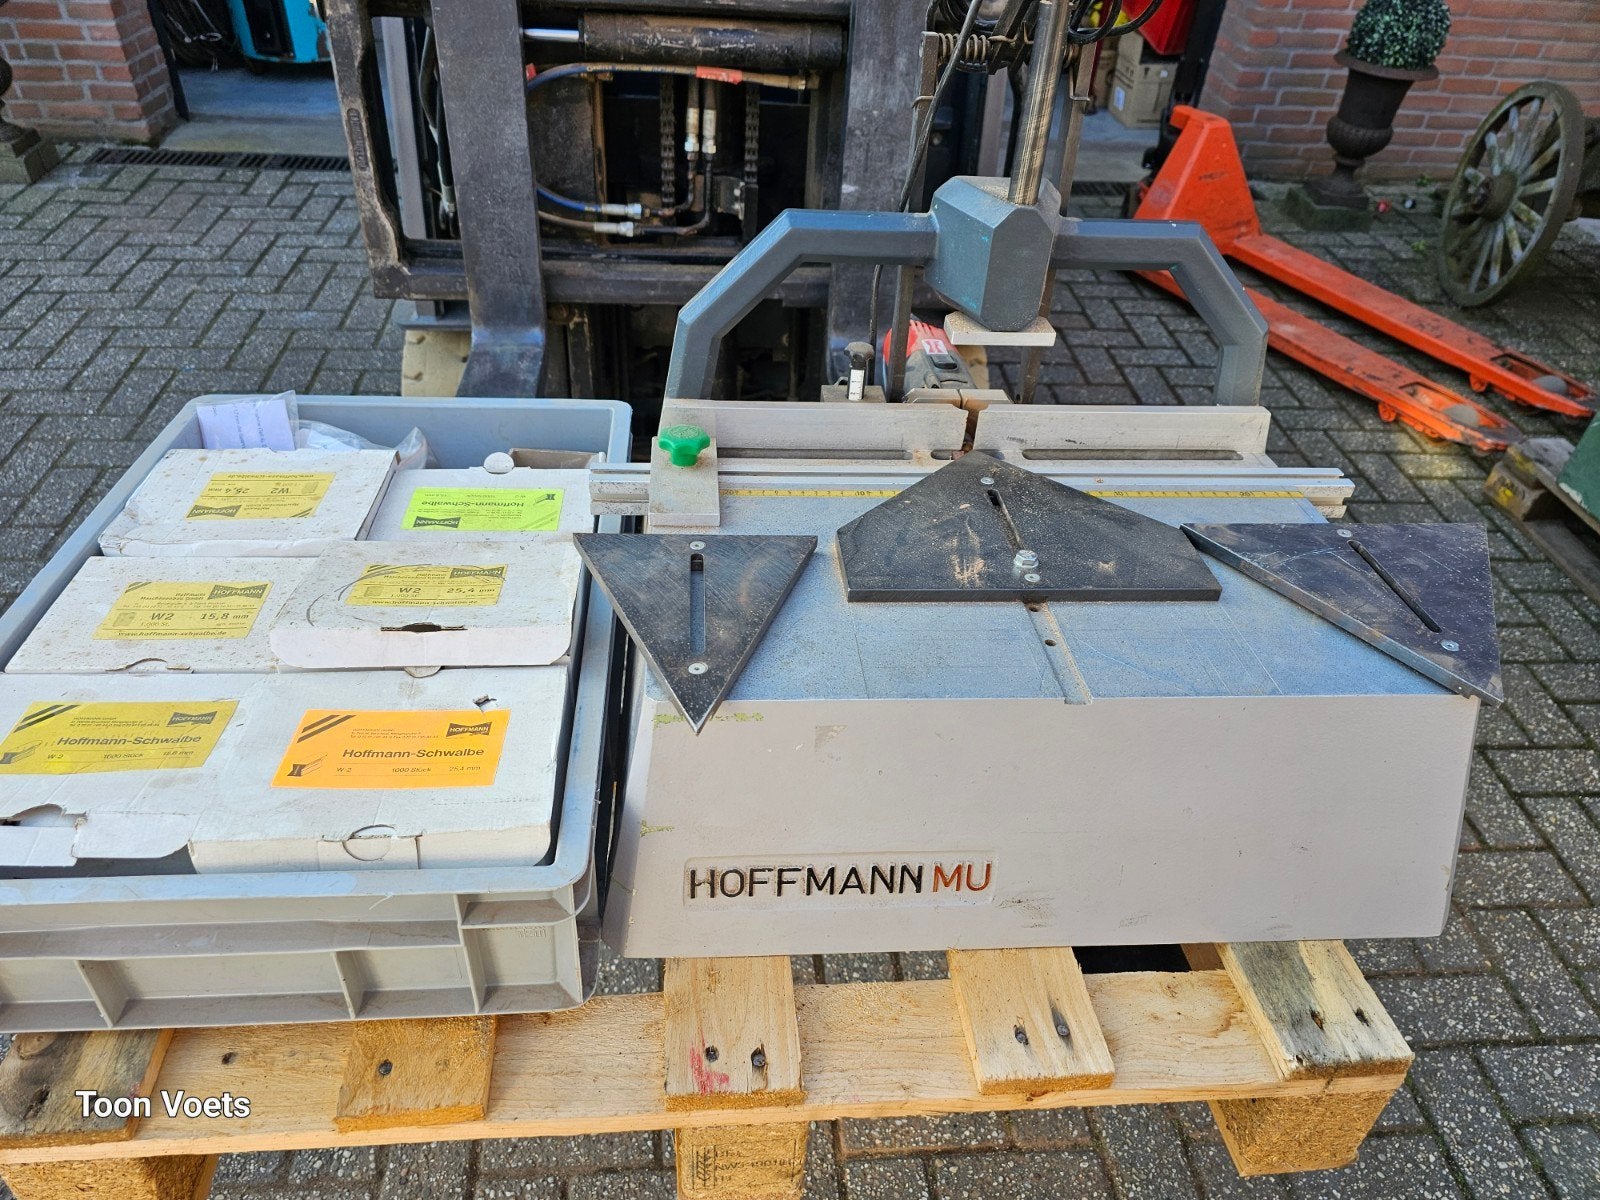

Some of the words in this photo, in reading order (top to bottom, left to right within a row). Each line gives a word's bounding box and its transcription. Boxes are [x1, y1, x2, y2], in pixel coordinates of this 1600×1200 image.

[421, 500, 524, 508] Hoffmann-Schwalbe
[191, 508, 236, 516] HOFFMANN
[414, 518, 459, 526] HOFFMANN
[212, 588, 265, 597] HOFFMANN
[151, 612, 176, 621] W2
[200, 612, 230, 622] 15,8
[172, 714, 214, 722] HOFFMANN
[450, 725, 490, 733] HOFFMANN
[57, 735, 202, 746] Hoffmann-Schwalbe
[342, 749, 485, 758] Hoffmann-Schwalbe
[689, 864, 923, 899] HOFFMANN
[931, 862, 992, 893] MU
